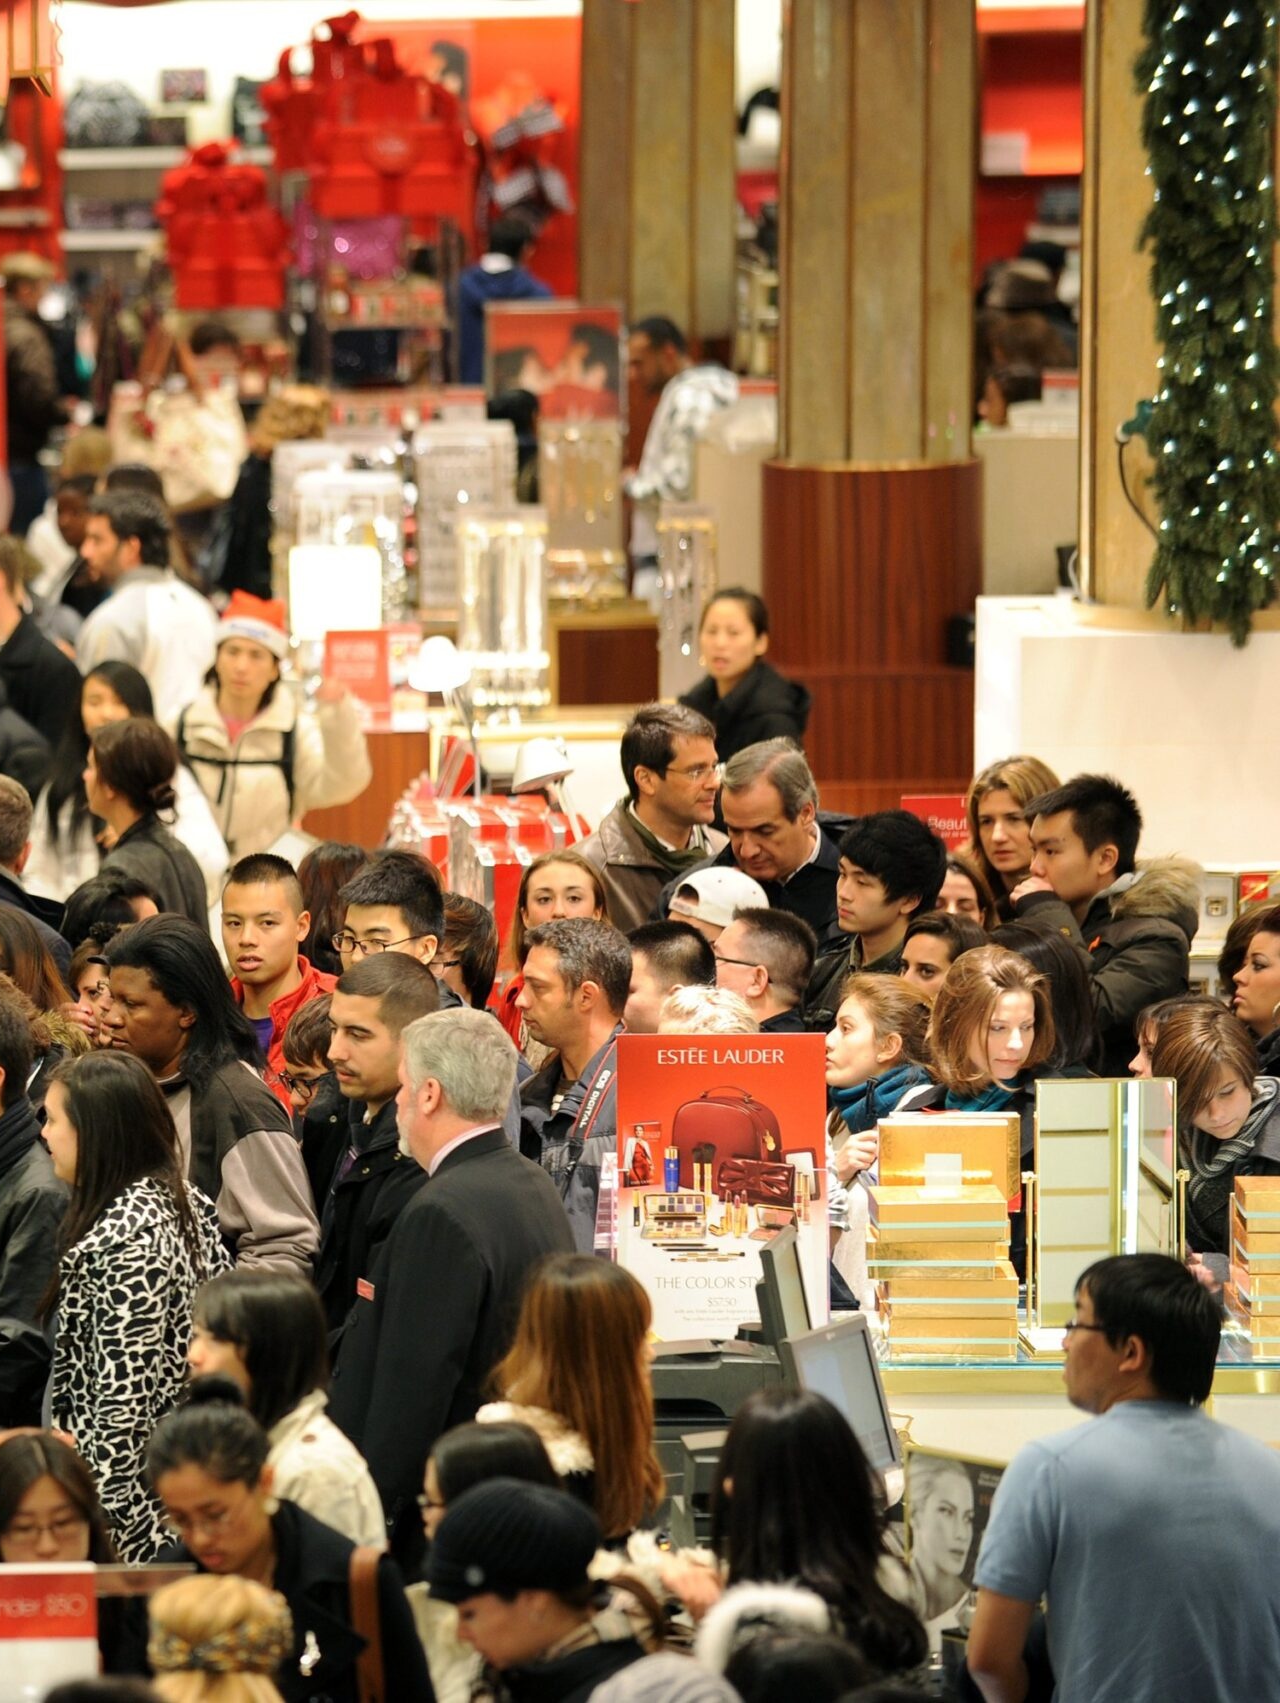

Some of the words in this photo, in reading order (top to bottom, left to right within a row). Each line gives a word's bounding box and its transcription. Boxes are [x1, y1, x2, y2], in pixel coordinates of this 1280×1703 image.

[713, 1049, 785, 1064] LAUDER
[579, 1090, 600, 1128] DIGITAL
[655, 1276, 682, 1290] THE
[685, 1276, 735, 1290] COLOR
[737, 1276, 763, 1290] STY
